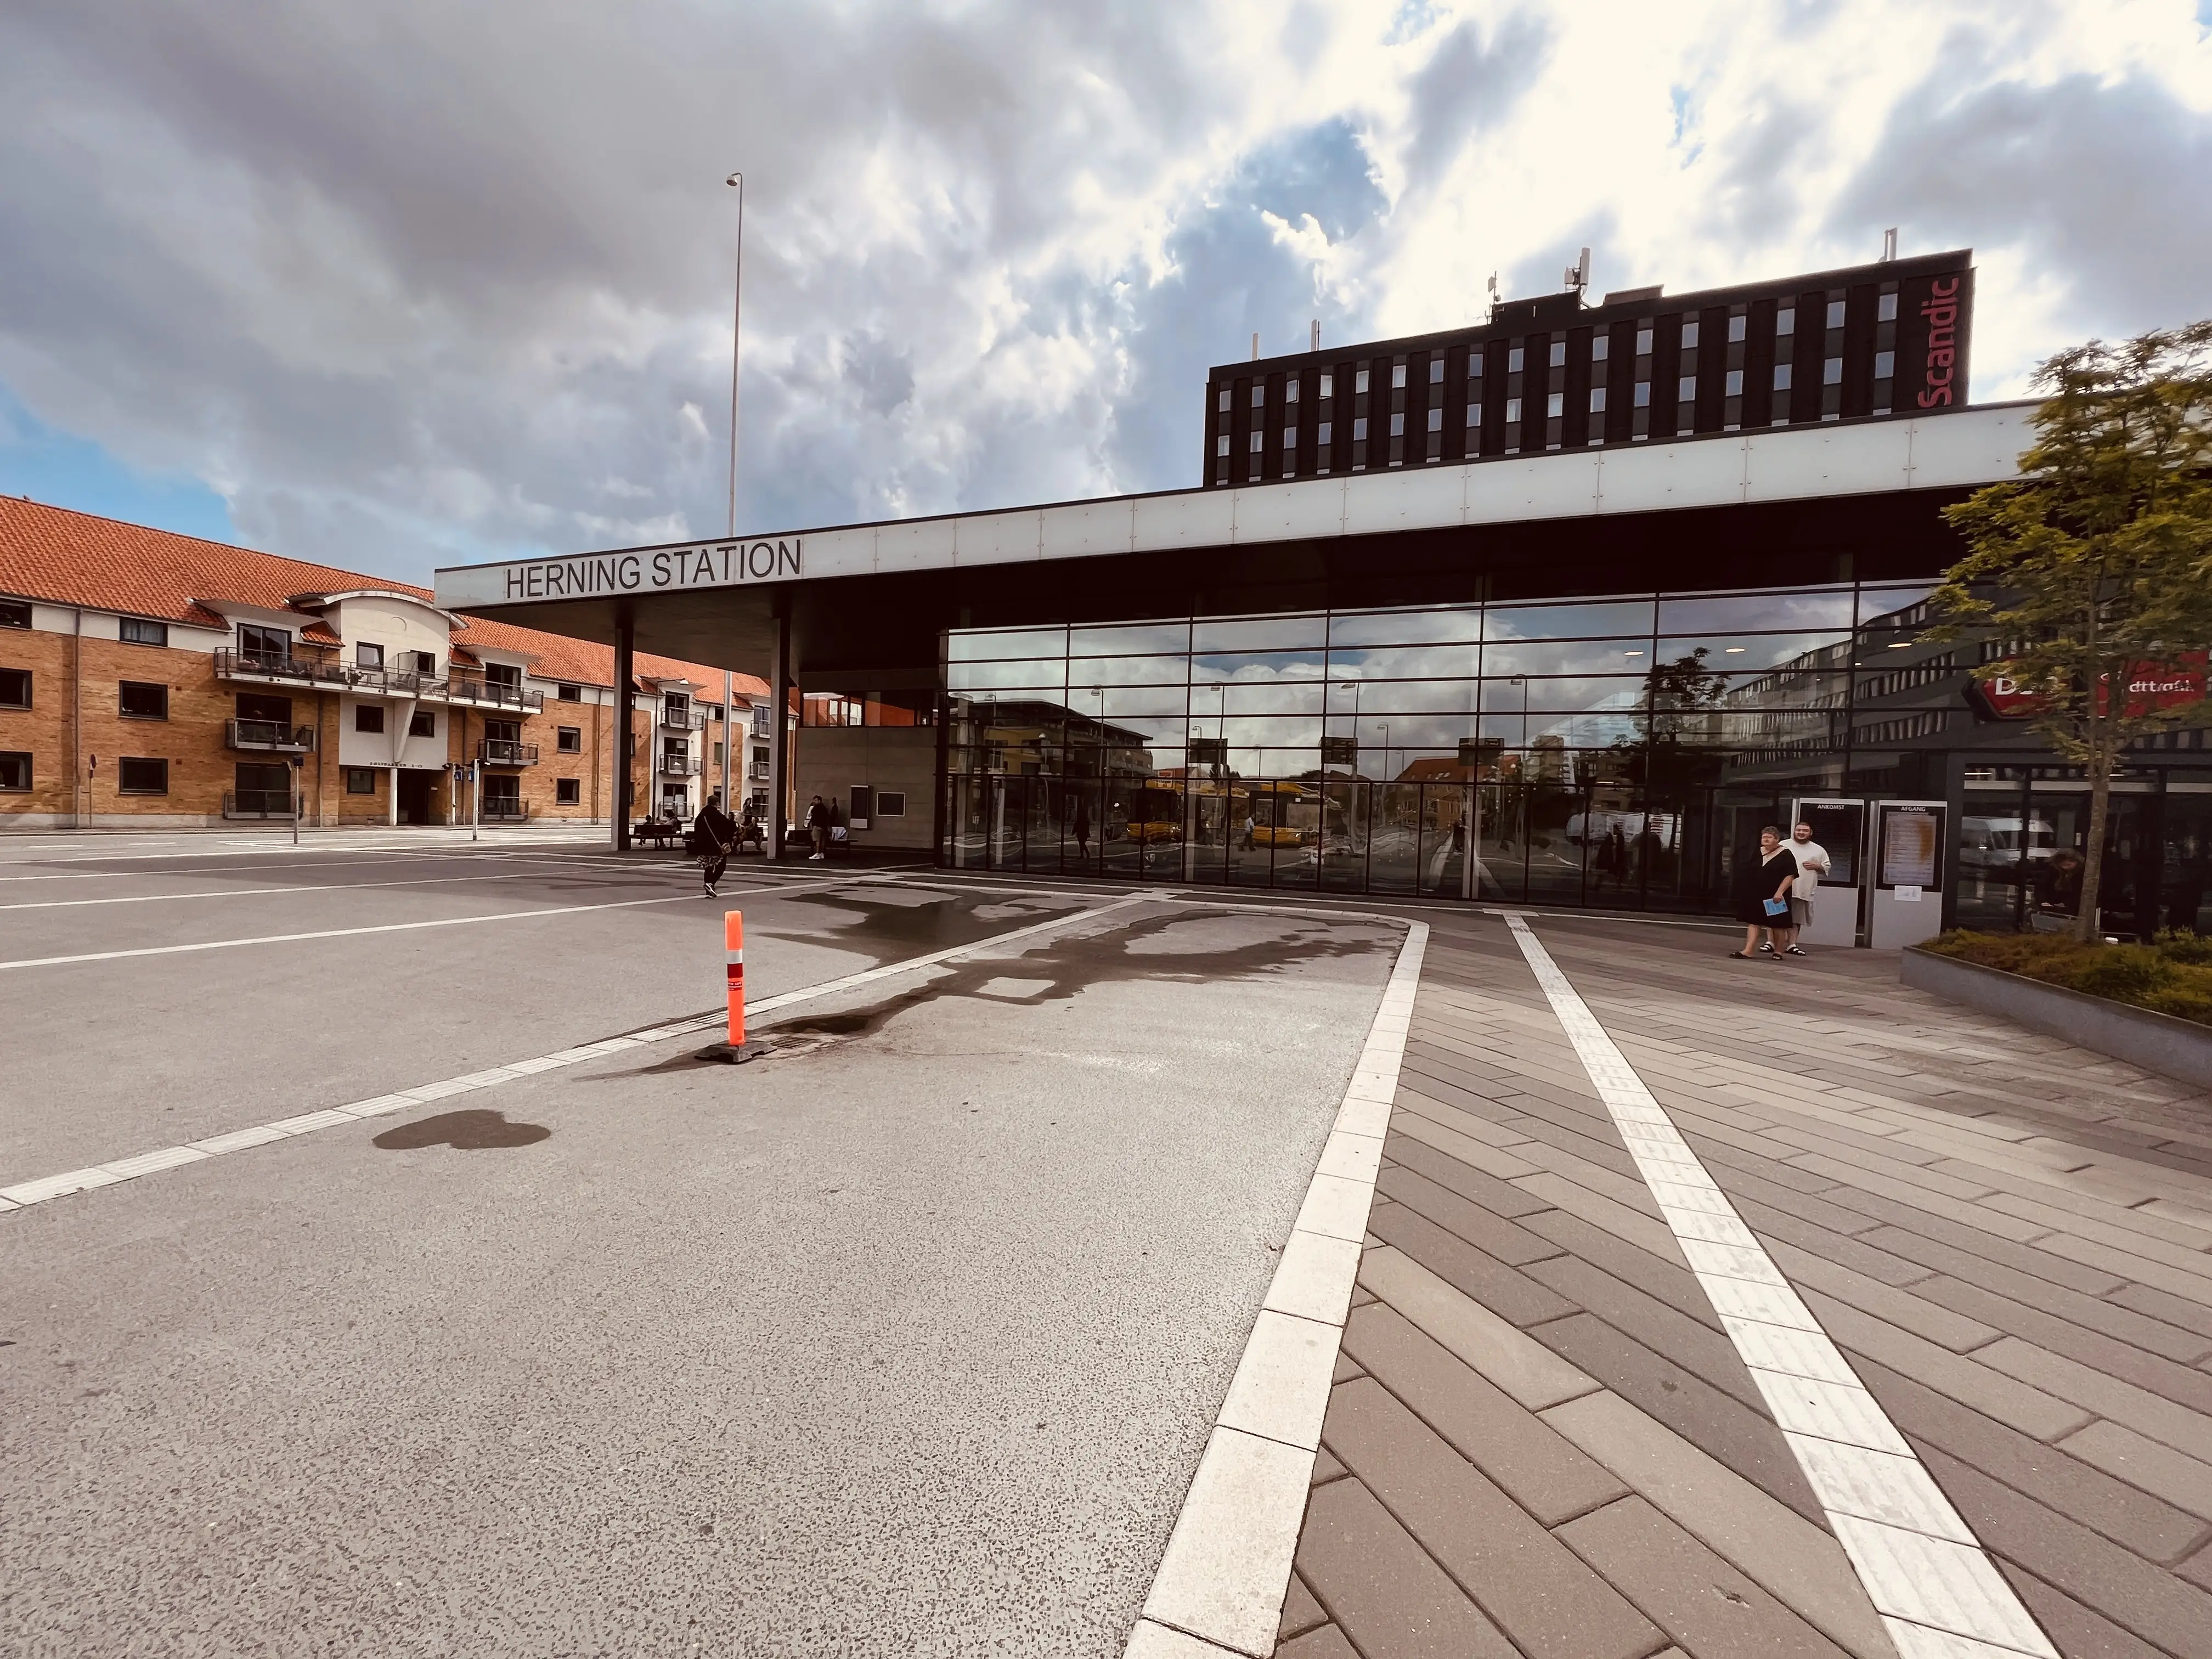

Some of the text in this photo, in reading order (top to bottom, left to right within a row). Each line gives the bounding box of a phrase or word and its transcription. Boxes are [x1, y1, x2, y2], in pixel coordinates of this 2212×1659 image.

[1917, 278, 1959, 408] Scandic
[507, 539, 801, 599] HERNING STATION
